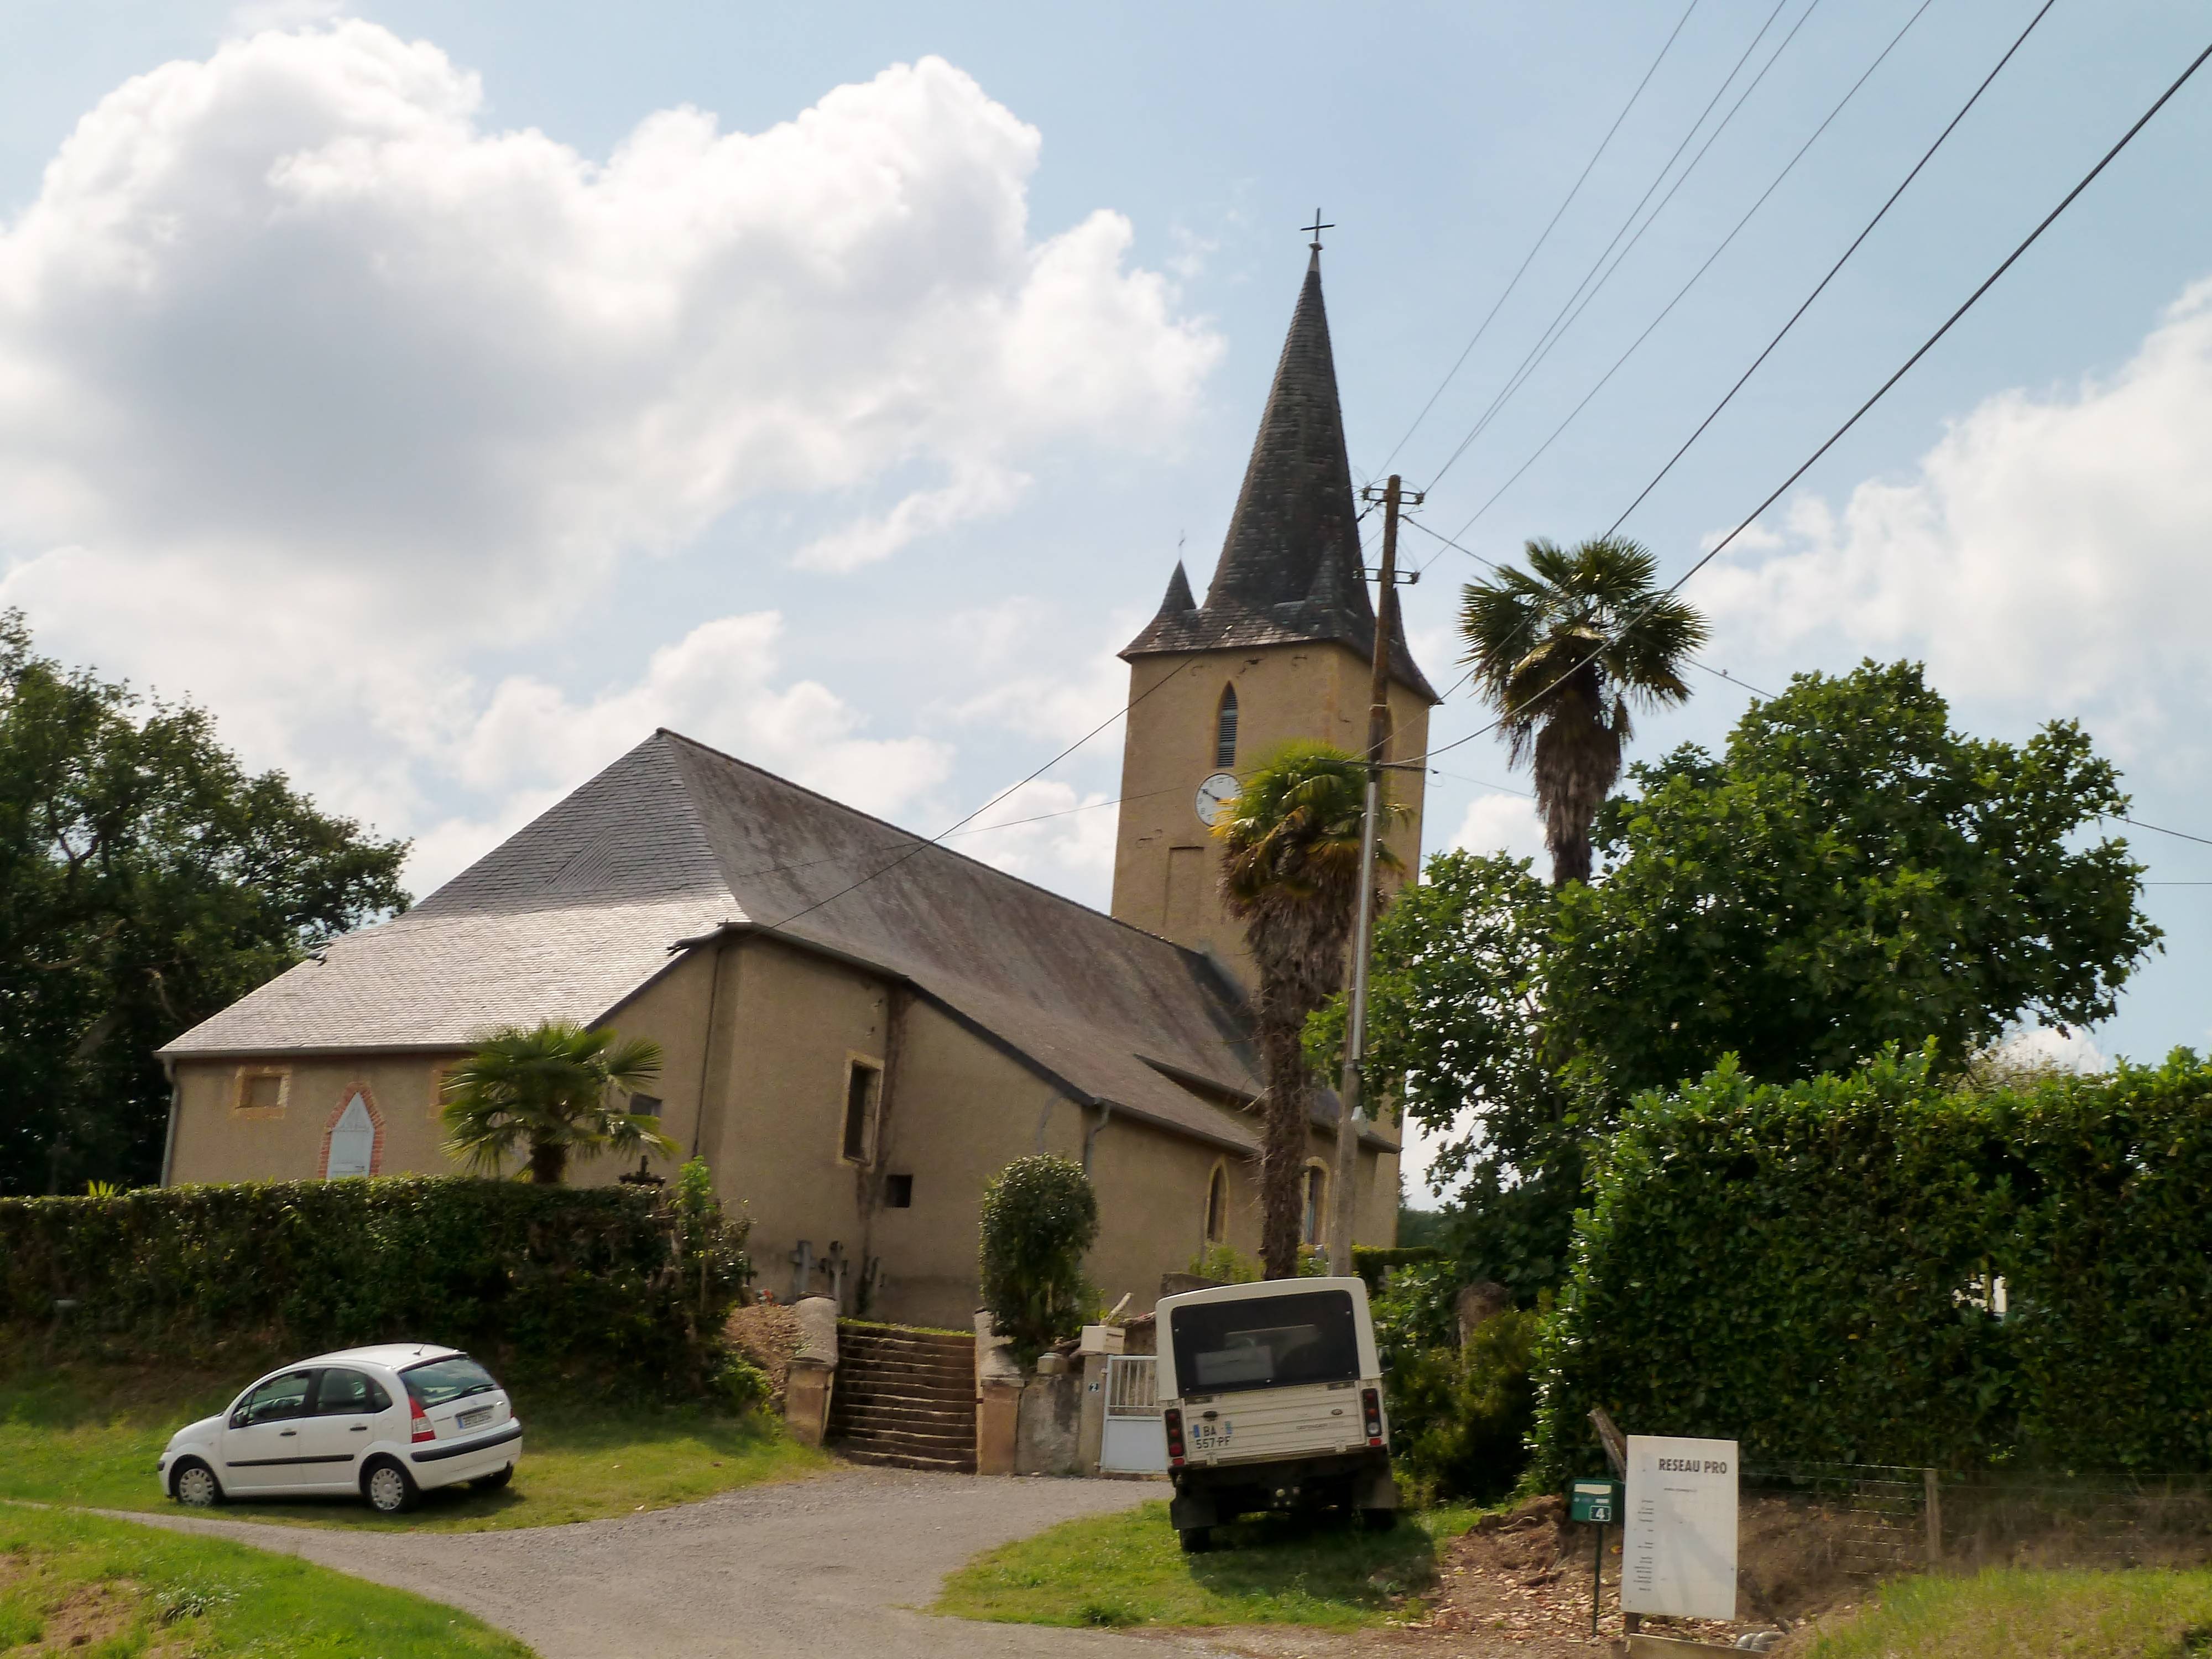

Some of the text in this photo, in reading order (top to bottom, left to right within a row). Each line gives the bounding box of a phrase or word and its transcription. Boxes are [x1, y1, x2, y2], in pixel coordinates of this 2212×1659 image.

[1203, 1425, 1216, 1437] BA
[1658, 1458, 1727, 1474] RESEAU PRO
[1595, 1507, 1605, 1520] 4
